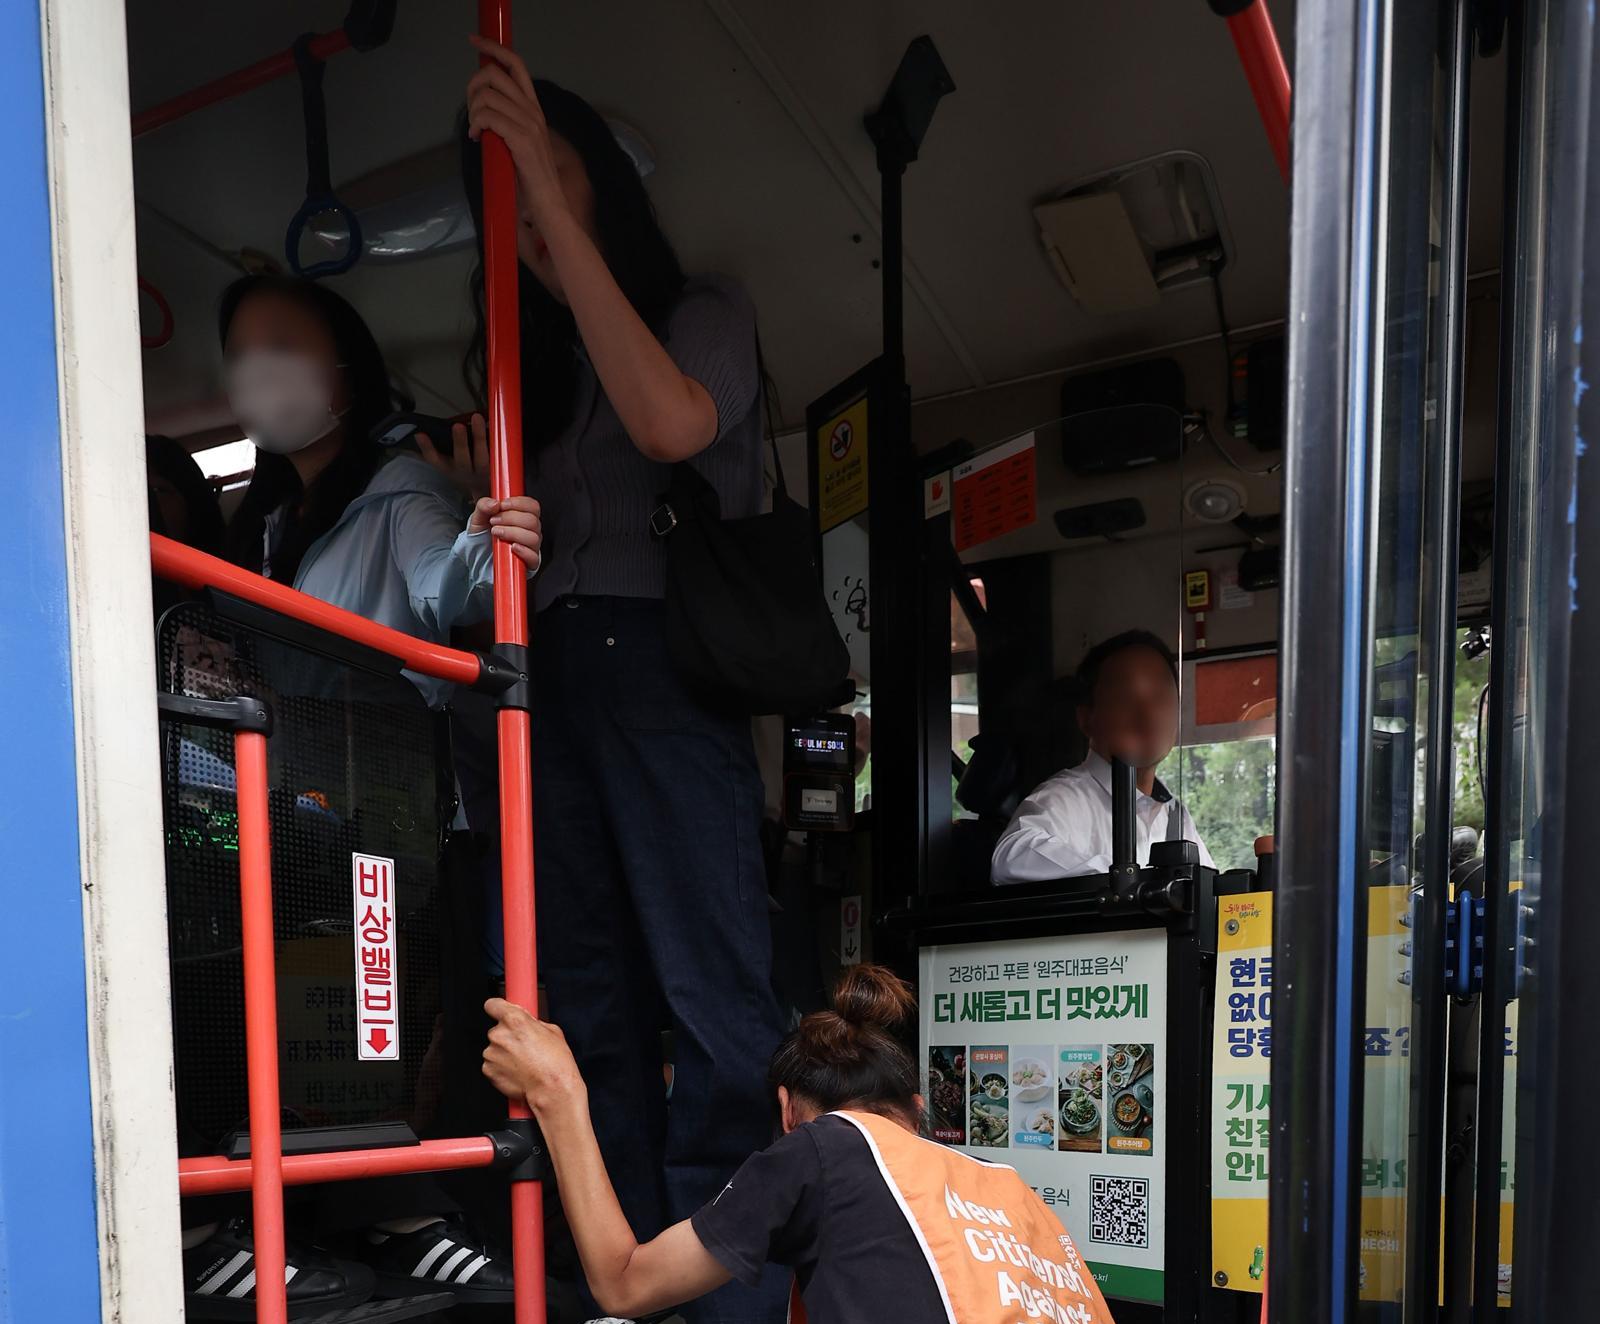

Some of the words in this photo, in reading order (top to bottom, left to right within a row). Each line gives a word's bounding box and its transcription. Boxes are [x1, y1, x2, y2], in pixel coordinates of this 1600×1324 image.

[359, 862, 394, 1024] 비상밸브
[949, 960, 999, 983] 건강하고
[1003, 959, 1030, 981] 푸른
[934, 992, 956, 1023] 더
[960, 988, 1031, 1022] 새롭고
[1036, 988, 1061, 1020] 더
[1066, 984, 1148, 1020] 맛있게
[944, 1183, 1012, 1228] New
[1042, 1187, 1070, 1207] 음식
[964, 1228, 1092, 1301] Citizensh
